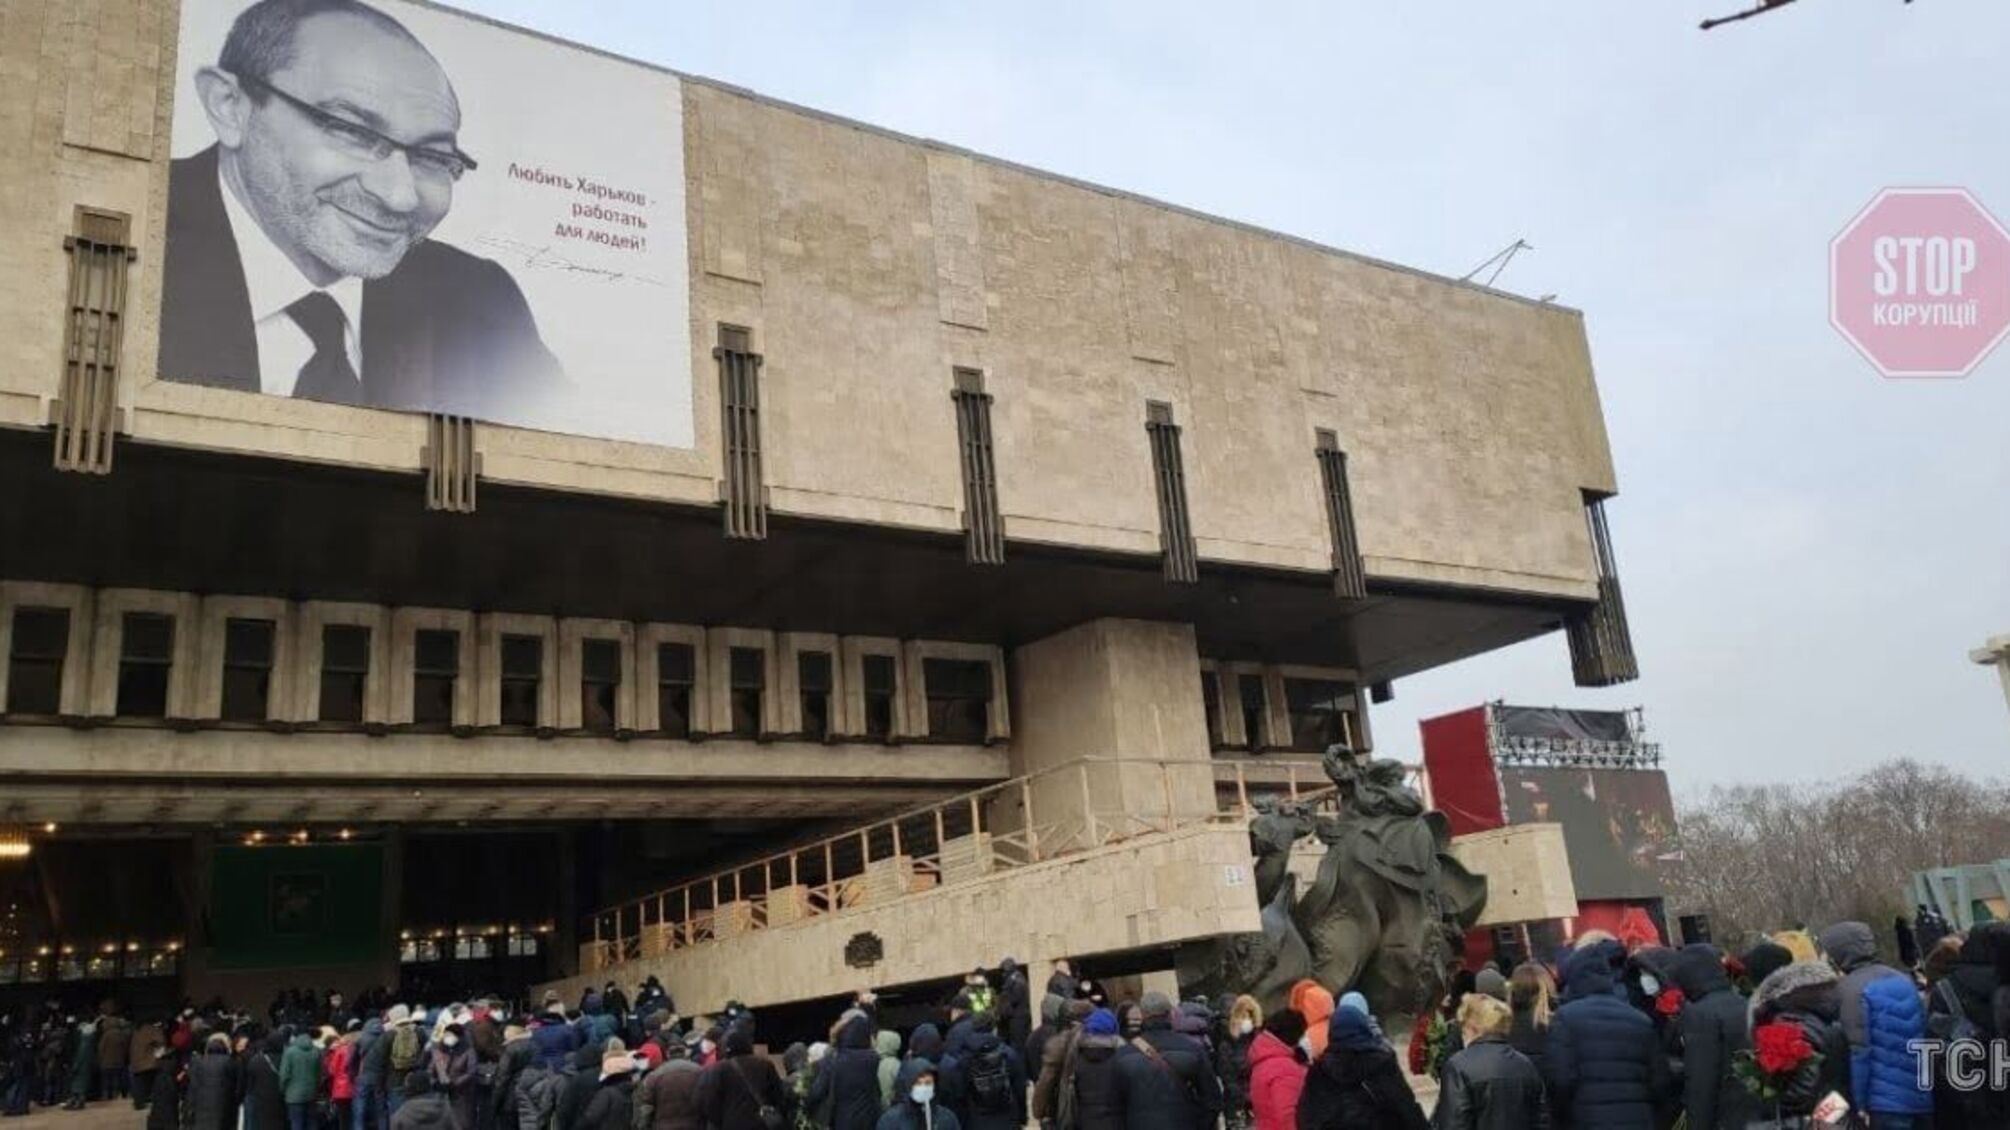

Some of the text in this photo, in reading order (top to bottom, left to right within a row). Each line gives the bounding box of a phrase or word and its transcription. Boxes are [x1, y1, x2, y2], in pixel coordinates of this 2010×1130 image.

[508, 162, 573, 190] Любить
[577, 177, 647, 206] Харьков
[571, 203, 648, 229] работать
[555, 223, 647, 252] для людей!
